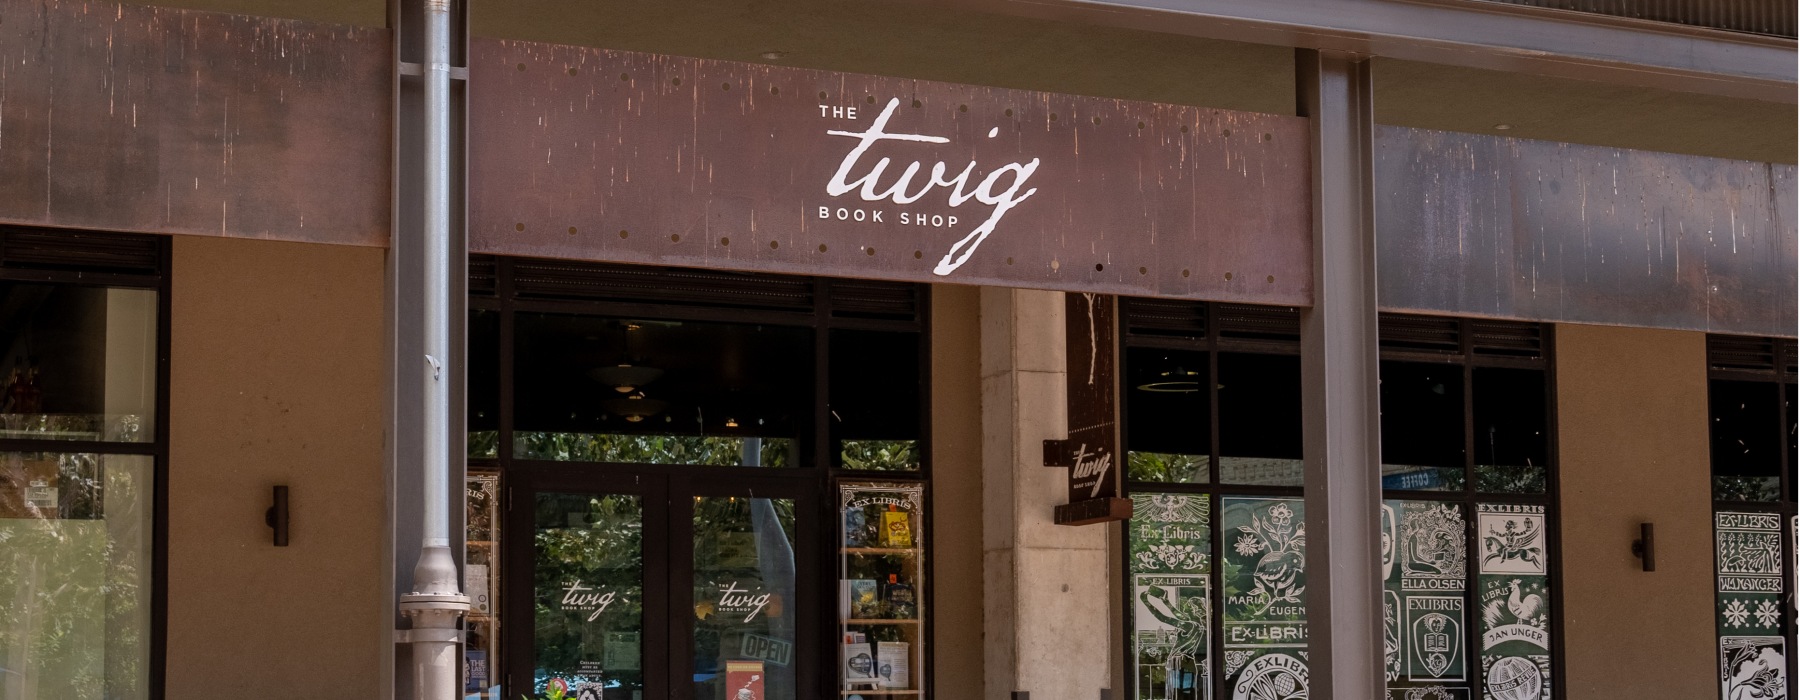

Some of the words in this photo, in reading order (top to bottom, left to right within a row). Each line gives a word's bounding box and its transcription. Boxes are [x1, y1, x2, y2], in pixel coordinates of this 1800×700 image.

[819, 105, 857, 120] THE
[826, 97, 1040, 276] twig
[819, 206, 883, 223] BOOK
[900, 212, 958, 228] SHOP
[1072, 443, 1111, 498] twig
[467, 489, 485, 500] RIS
[853, 498, 871, 508] EX
[872, 497, 911, 510] LIBRIS
[1478, 504, 1545, 513] EXLIBRIS
[1140, 525, 1159, 541] Ex
[1162, 525, 1201, 542] Libris
[1401, 579, 1427, 589] ELLA
[1428, 579, 1466, 589] OLSEN
[1487, 580, 1500, 589] EX
[561, 579, 616, 621] twig
[719, 581, 771, 623] twig
[1228, 596, 1266, 605] MARIA
[1481, 587, 1509, 602] LIBRIS
[1409, 599, 1462, 611] EXLIBRIS
[1489, 629, 1508, 642] JAN
[1511, 628, 1543, 643] UNGER
[745, 635, 789, 664] OPEN
[470, 659, 486, 667] THE
